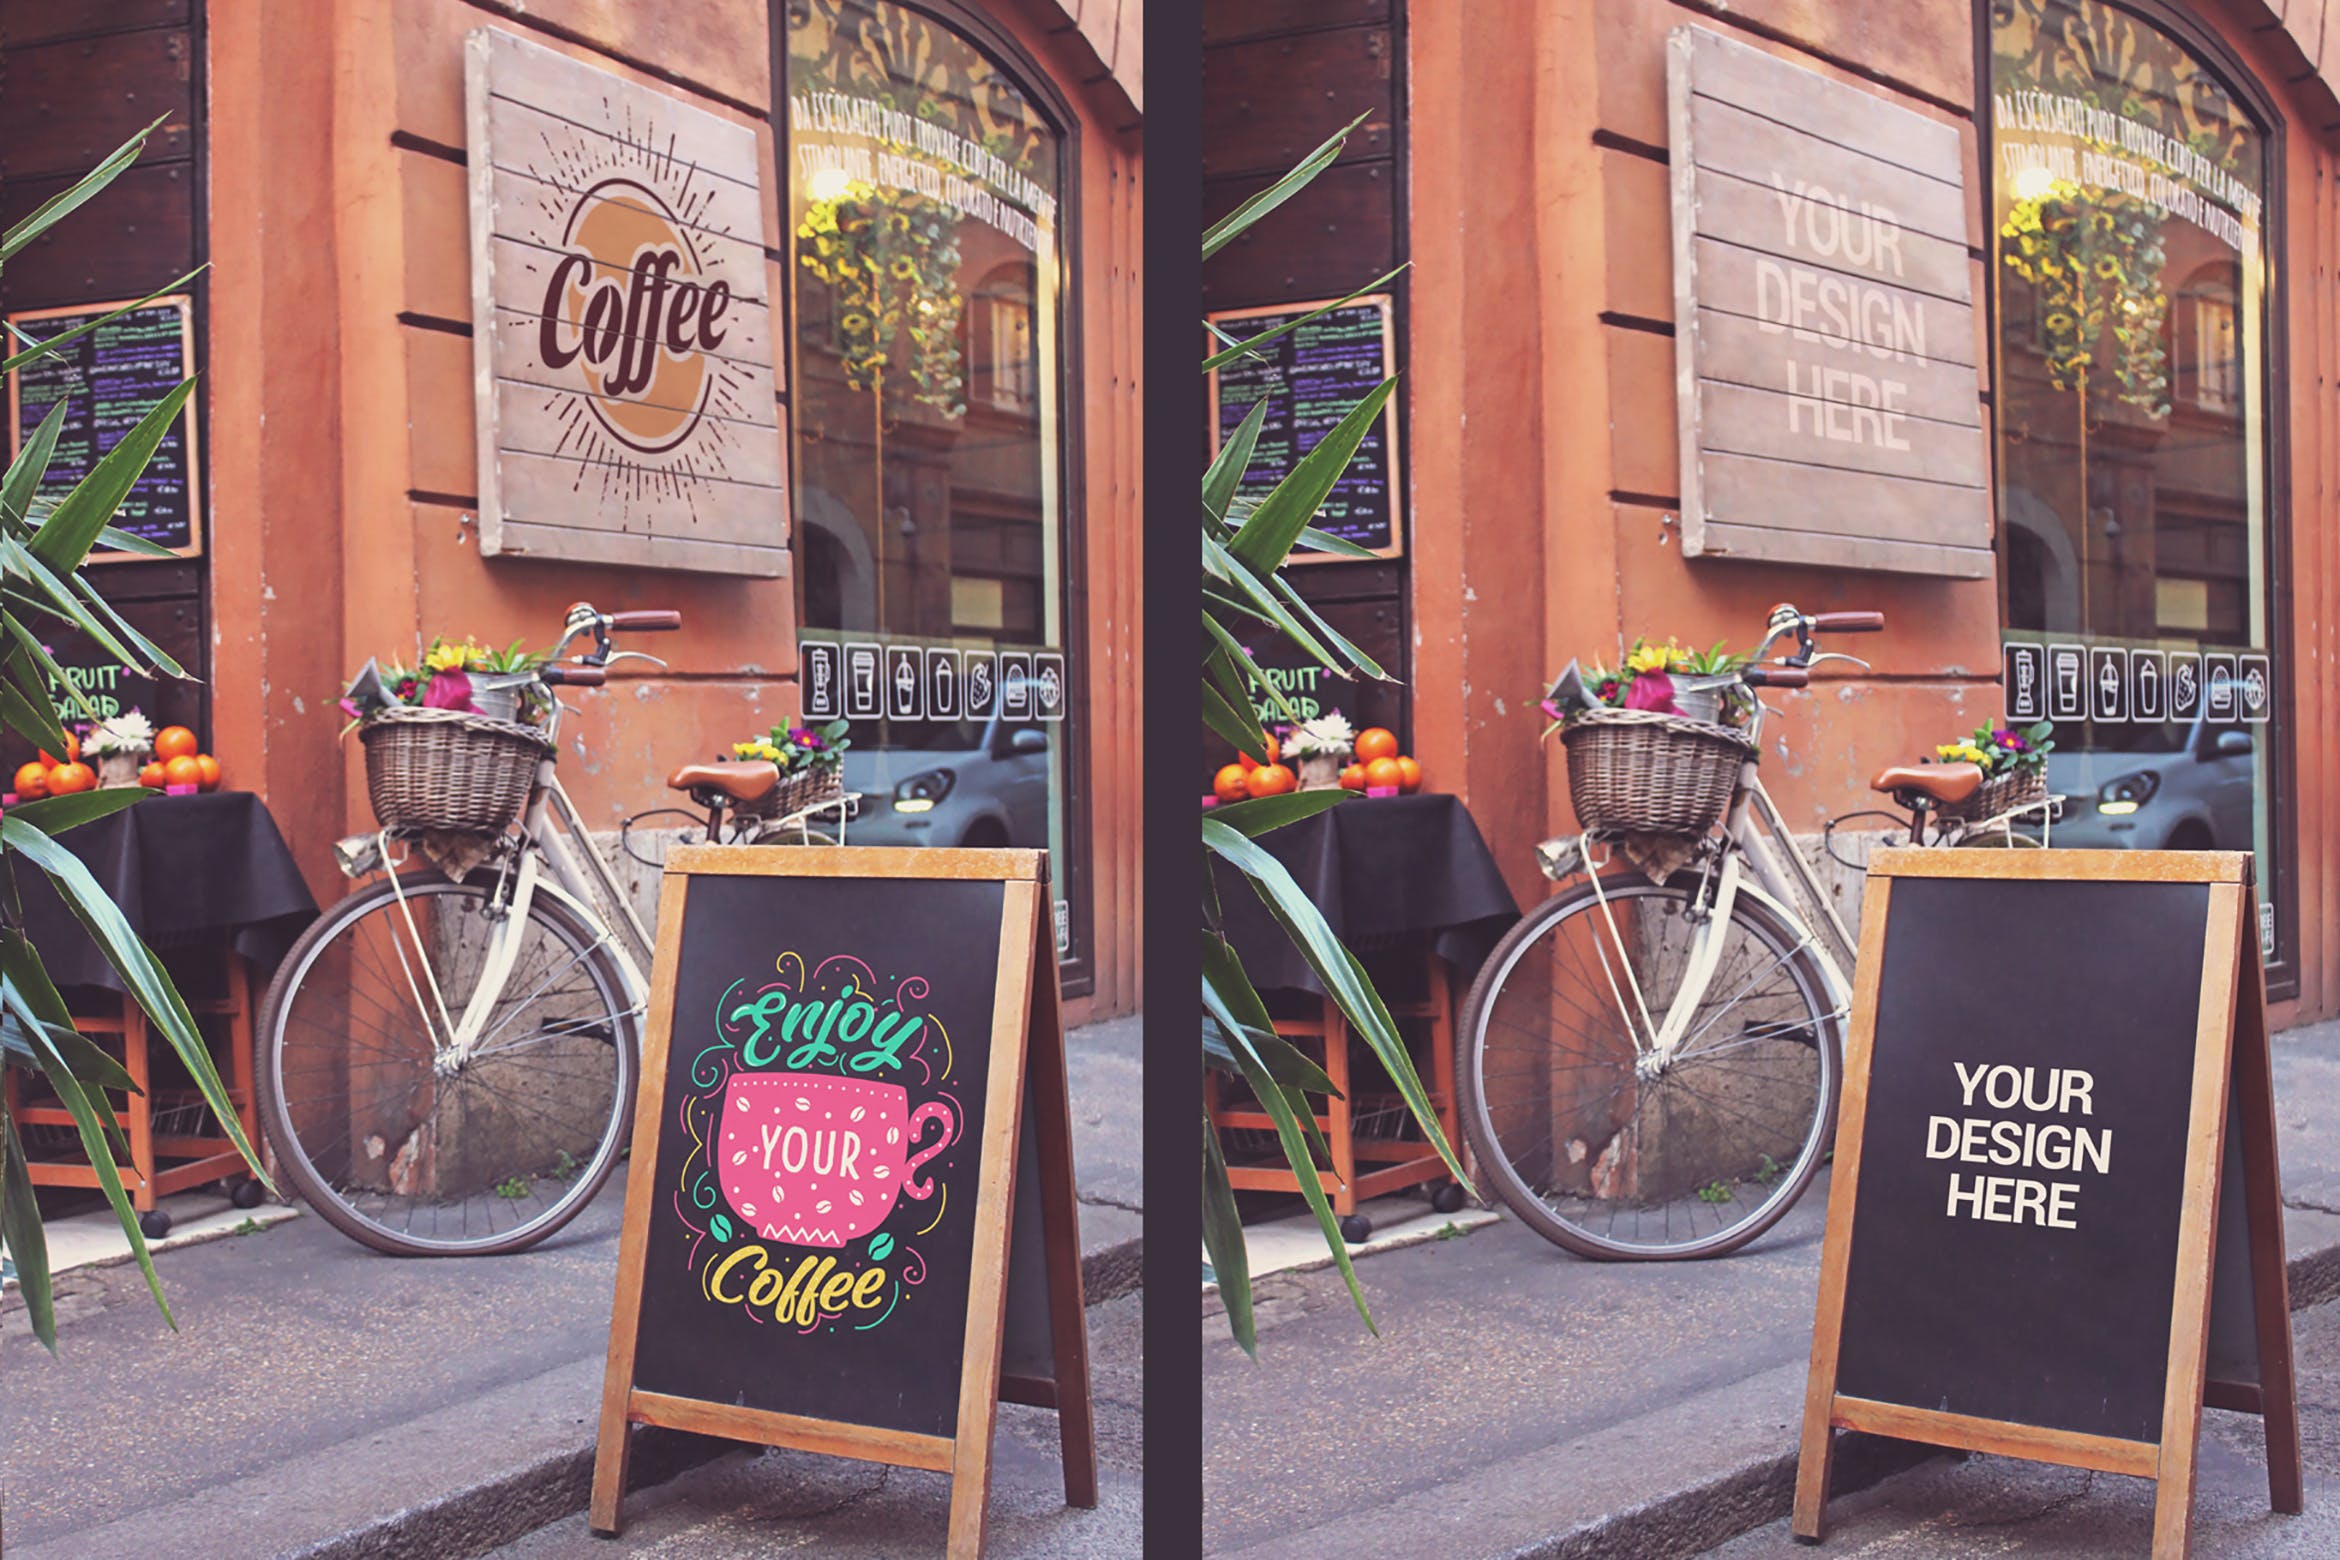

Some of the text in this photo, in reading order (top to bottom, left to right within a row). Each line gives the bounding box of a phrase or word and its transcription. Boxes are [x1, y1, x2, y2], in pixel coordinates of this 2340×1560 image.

[1007, 166, 1021, 201] LA
[2212, 165, 2226, 200] LA
[1771, 171, 1904, 278] YOUR
[540, 249, 730, 397] Coffee
[1756, 258, 1928, 368] DESIGN
[1787, 359, 1911, 451] HERE
[48, 664, 121, 692] FRUIT
[1247, 666, 1322, 694] FRUIT
[730, 984, 923, 1072] Enjoy
[1953, 1061, 2094, 1115] YOUR
[761, 1124, 861, 1180] YOUR
[1926, 1115, 2113, 1174] DESIGN
[1946, 1173, 2081, 1229] HERE
[710, 1245, 887, 1326] Coffee
